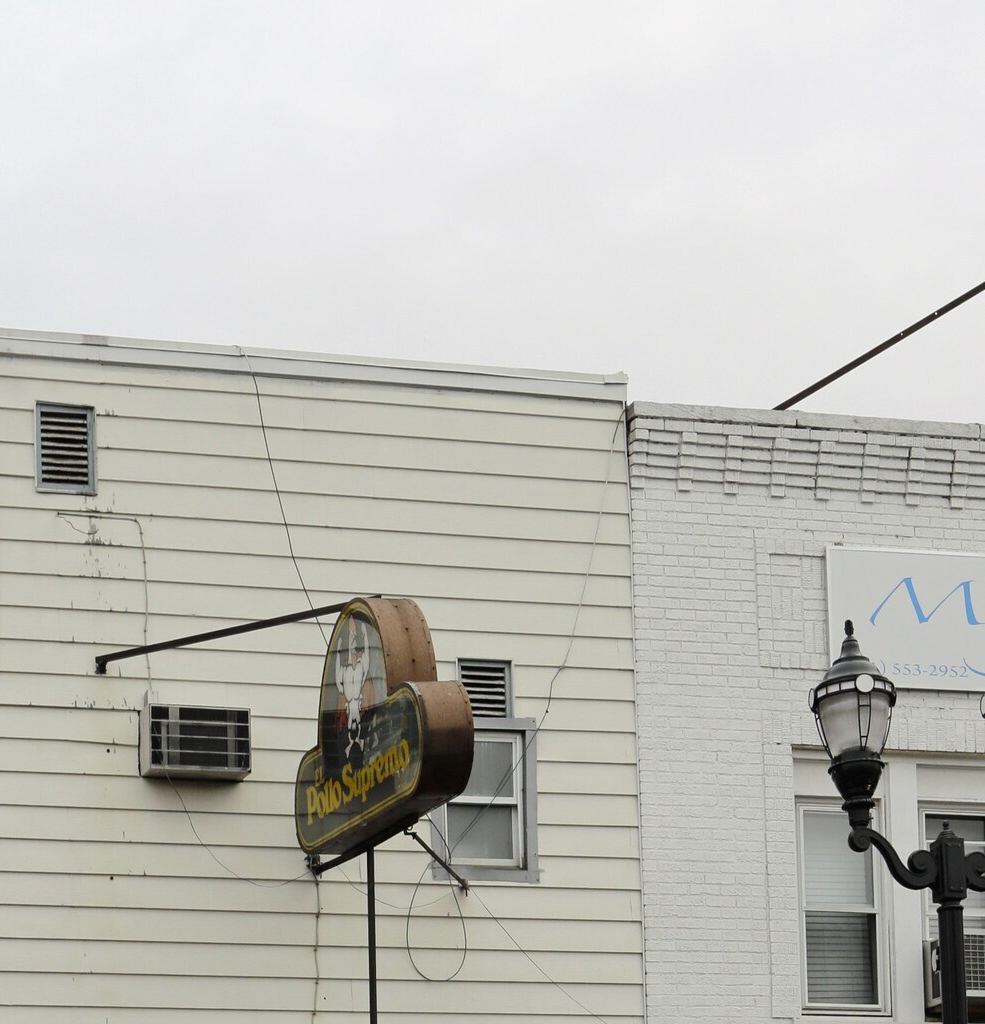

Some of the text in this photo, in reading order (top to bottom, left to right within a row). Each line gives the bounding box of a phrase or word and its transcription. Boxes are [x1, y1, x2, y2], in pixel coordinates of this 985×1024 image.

[892, 663, 969, 678] 553-2952
[306, 741, 410, 826] Pollo Supremo
